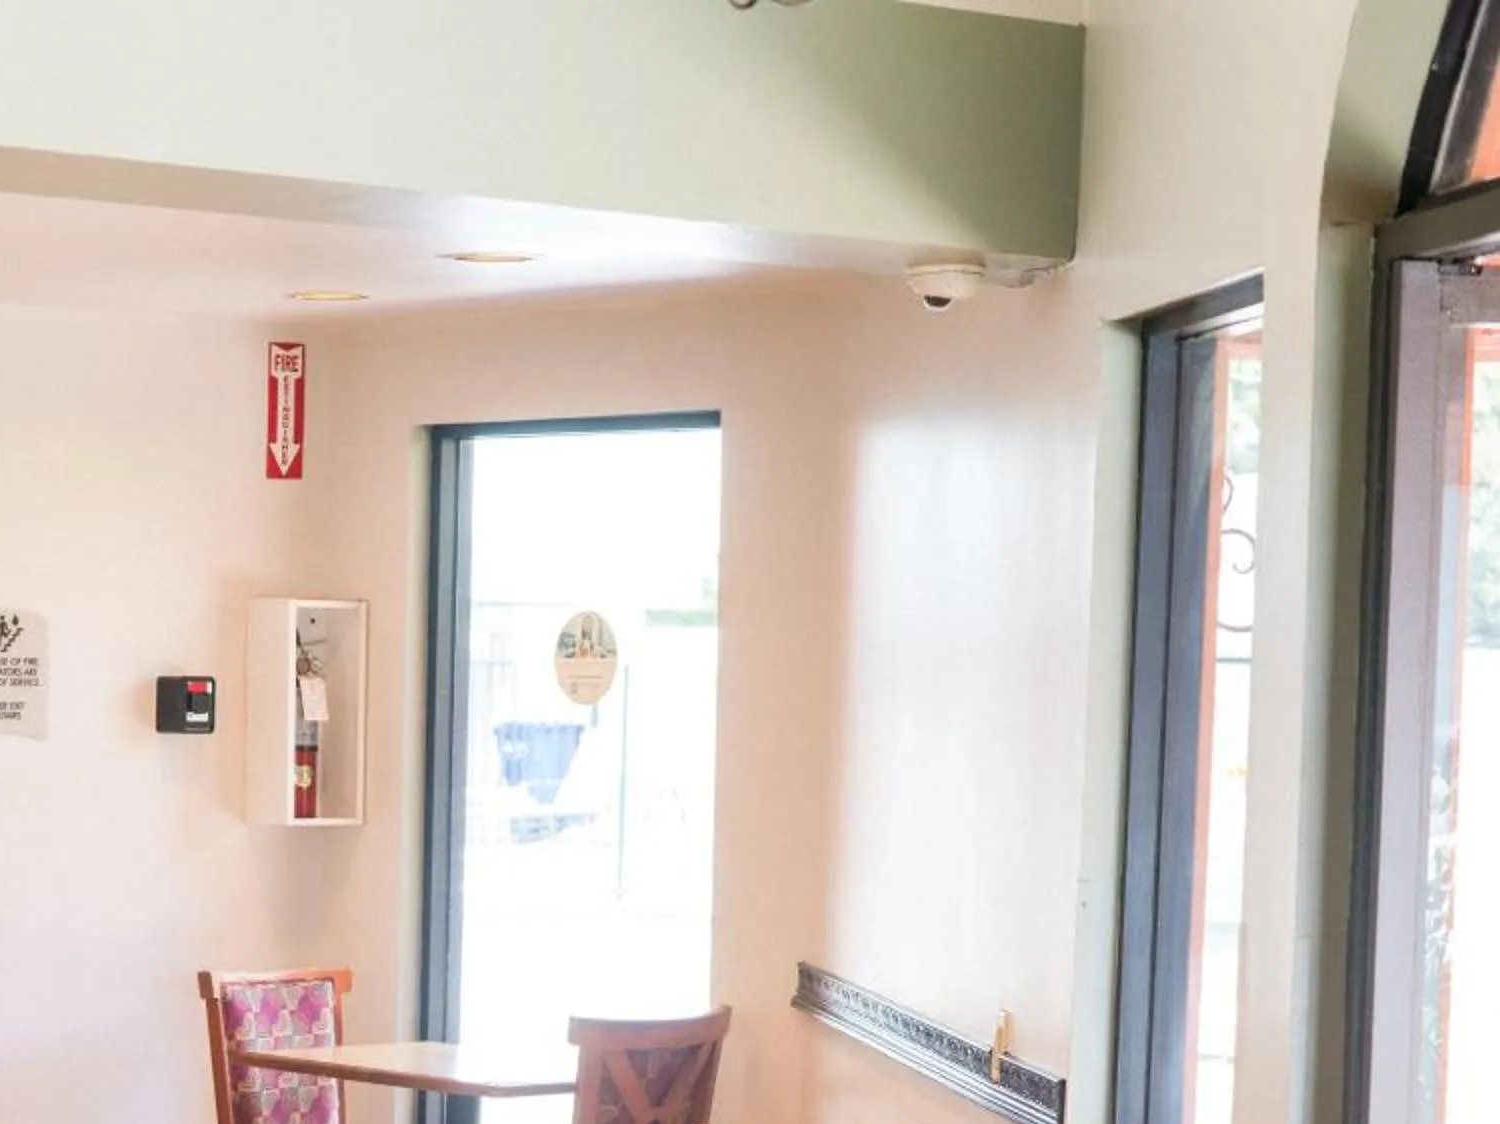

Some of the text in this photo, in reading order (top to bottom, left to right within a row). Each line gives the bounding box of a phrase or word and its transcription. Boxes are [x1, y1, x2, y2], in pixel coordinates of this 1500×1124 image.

[274, 354, 299, 372] FIRE
[281, 375, 290, 466] EXTINGUISHER
[10, 657, 21, 666] OF
